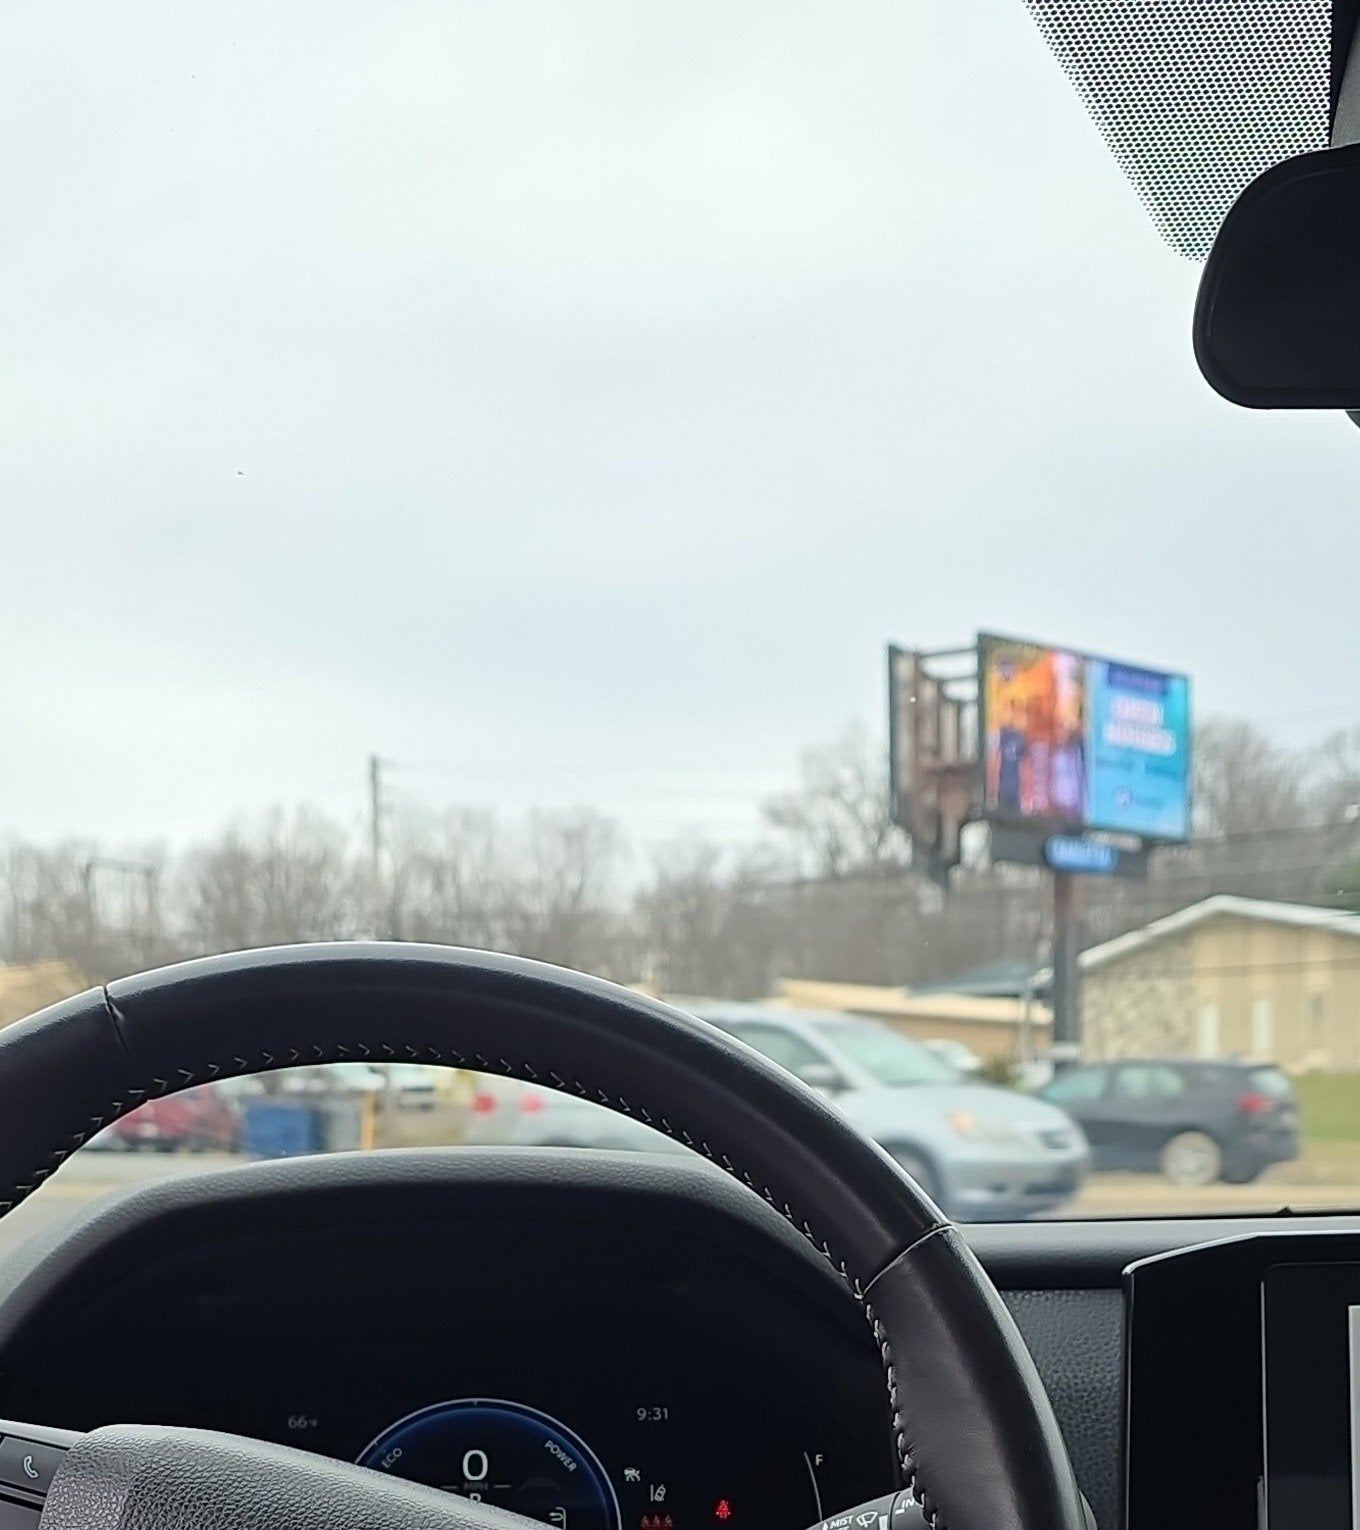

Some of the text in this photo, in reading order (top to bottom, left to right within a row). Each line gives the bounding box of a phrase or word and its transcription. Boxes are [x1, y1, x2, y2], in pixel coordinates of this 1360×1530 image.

[636, 1406, 669, 1421] 9:31
[380, 1447, 403, 1469] ECO
[462, 1449, 489, 1481] 0
[544, 1440, 578, 1472] POWER
[815, 1454, 824, 1466] F
[830, 1515, 854, 1530] MIST
